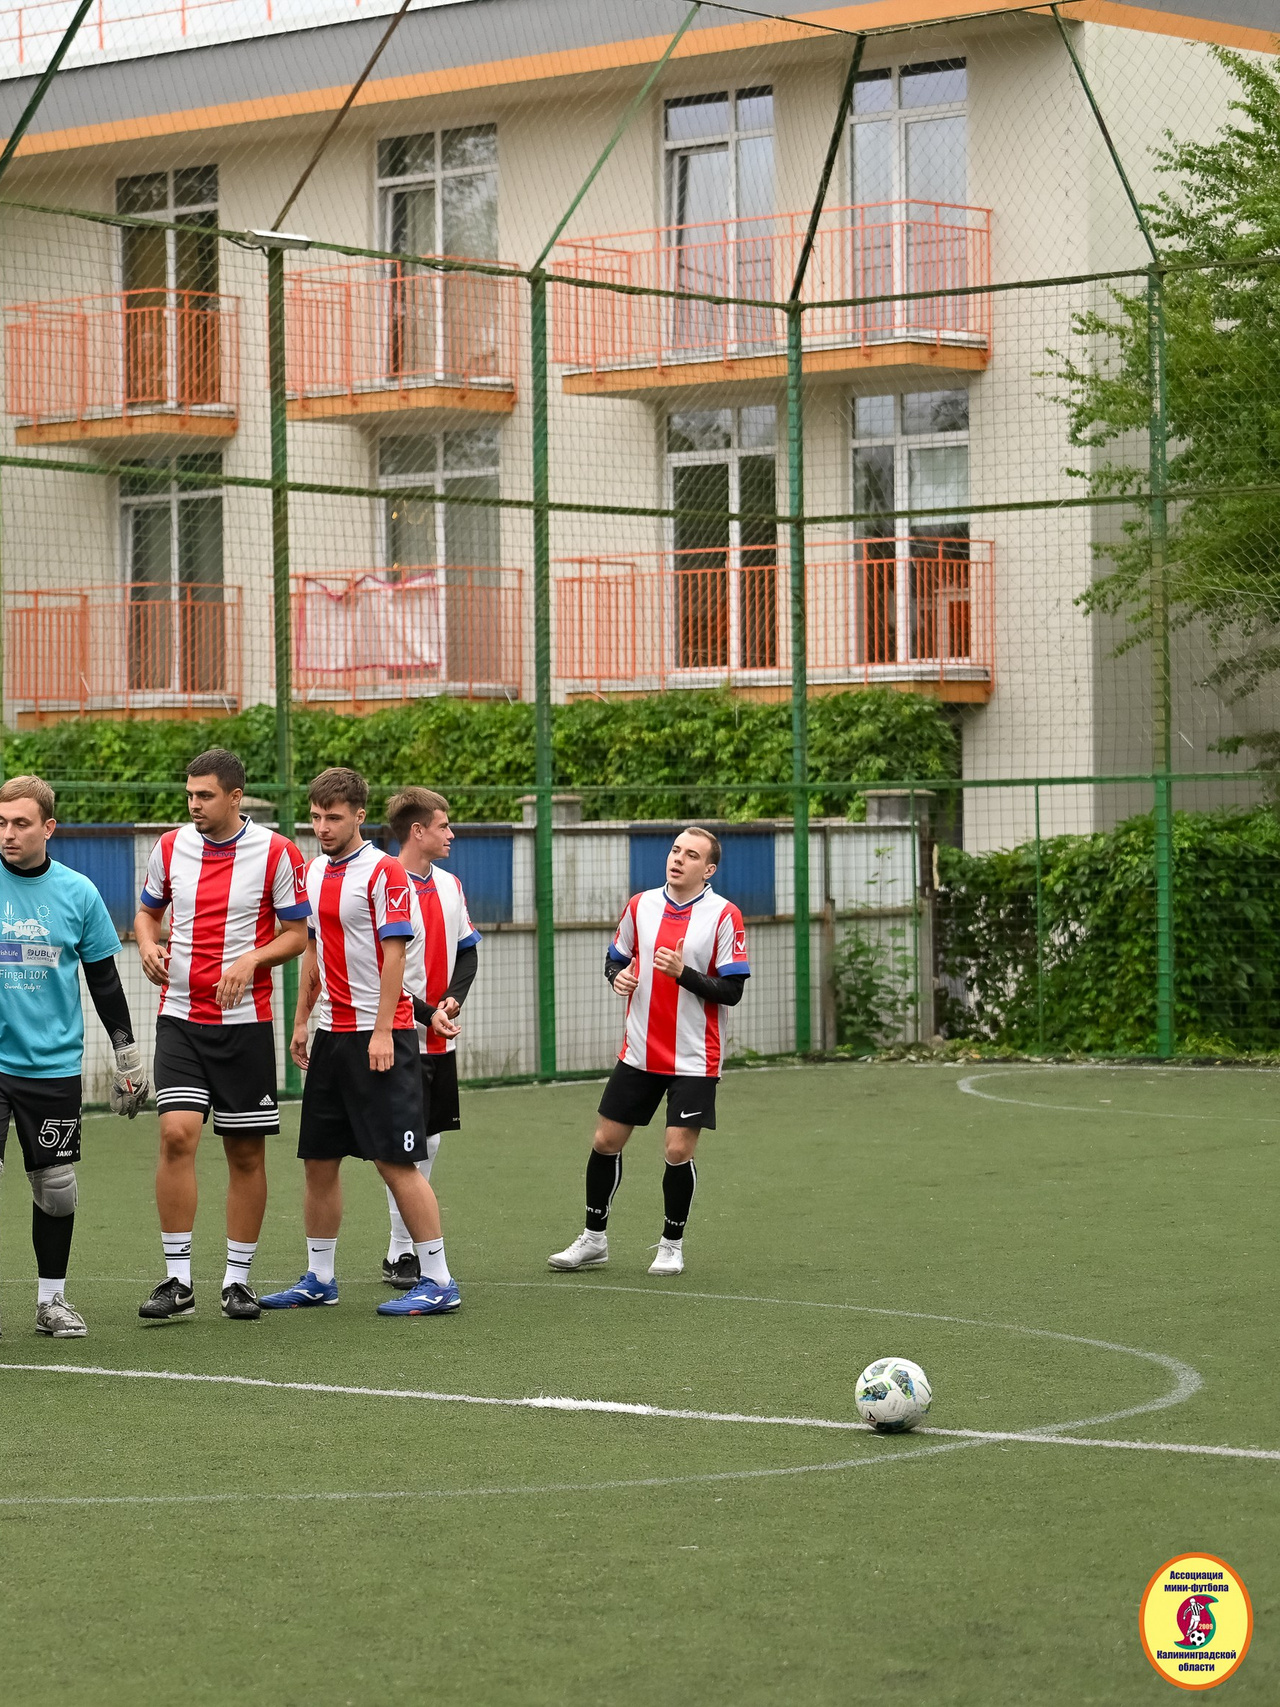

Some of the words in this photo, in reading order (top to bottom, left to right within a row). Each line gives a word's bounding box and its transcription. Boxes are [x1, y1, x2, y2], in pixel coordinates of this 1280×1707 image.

[29, 970, 40, 980] 10
[41, 970, 49, 980] K
[38, 1118, 78, 1149] 57
[403, 1129, 415, 1152] 8
